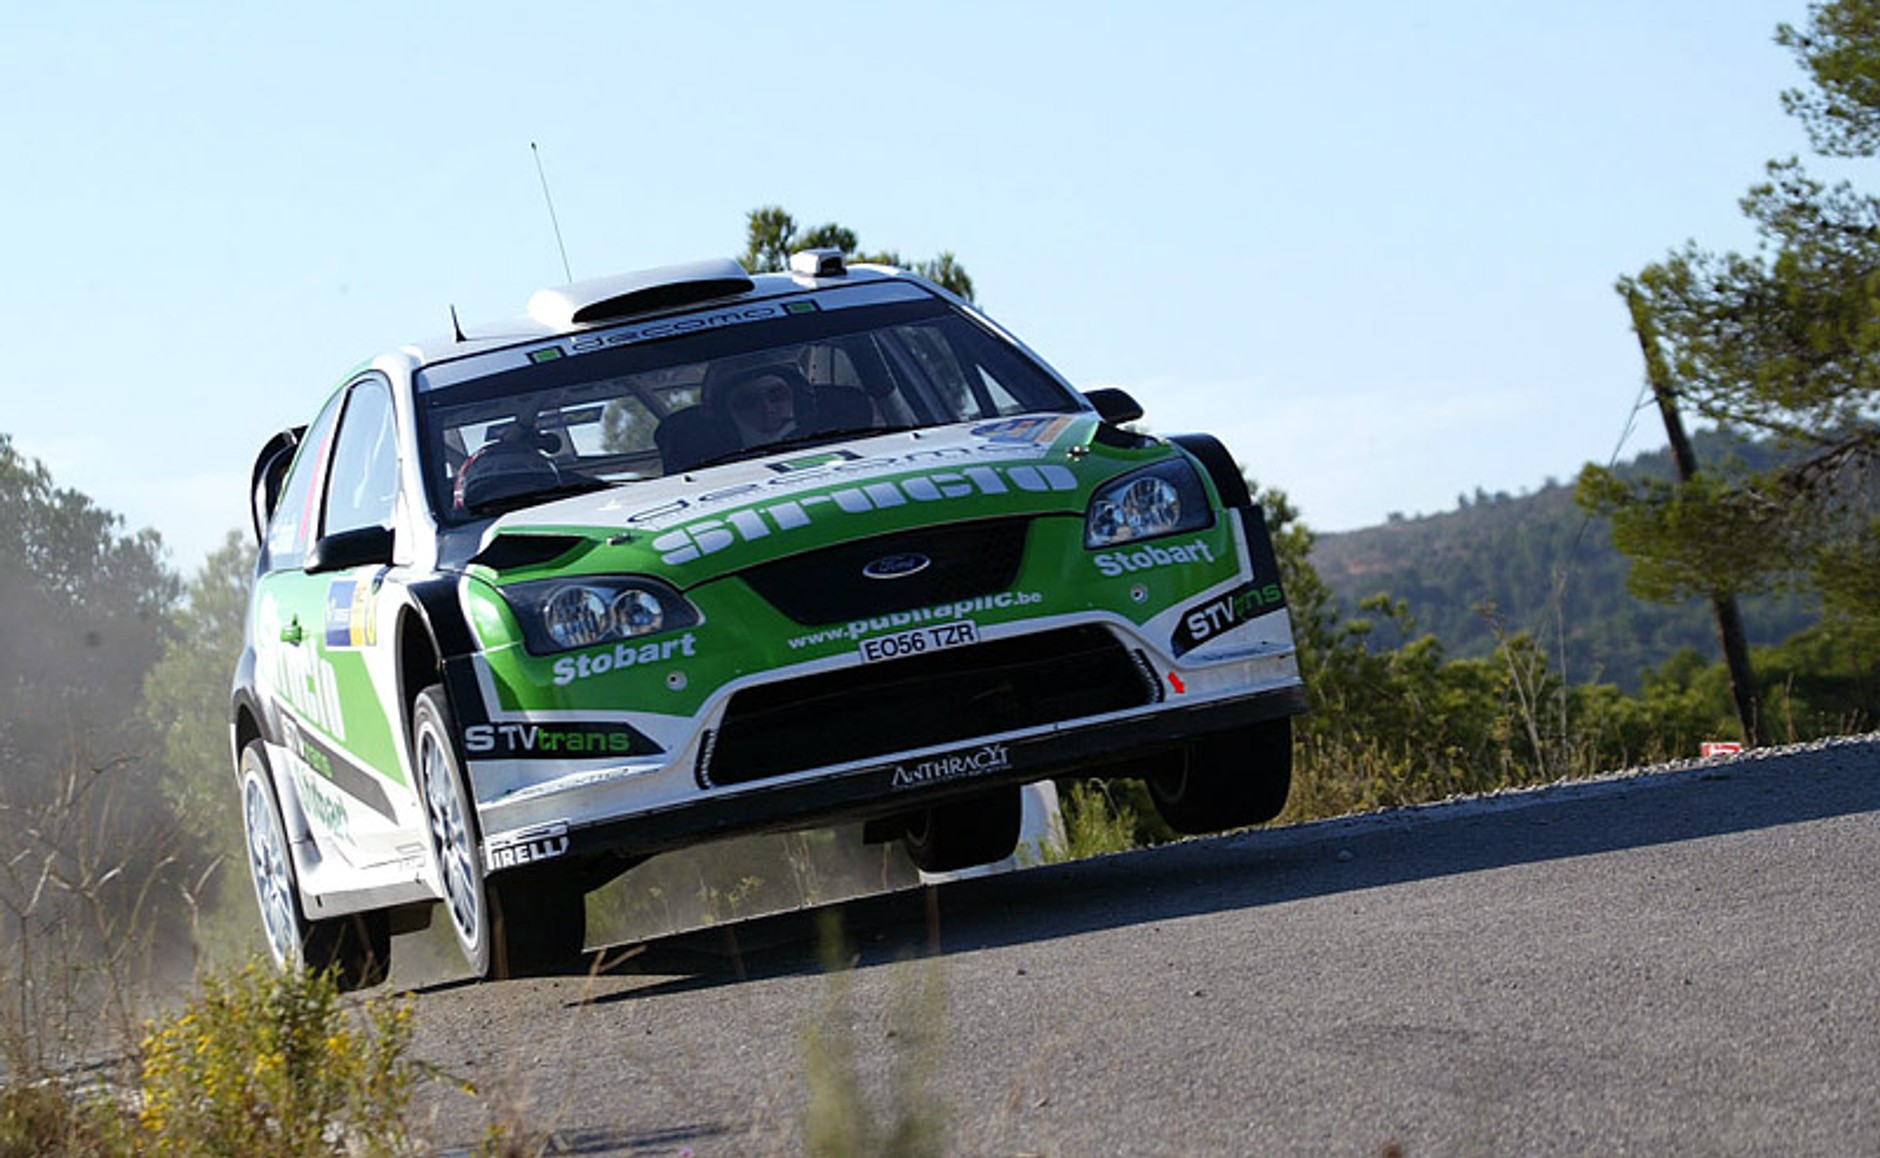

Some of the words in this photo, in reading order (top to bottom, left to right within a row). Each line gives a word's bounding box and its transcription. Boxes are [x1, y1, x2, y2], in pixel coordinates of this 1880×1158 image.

[652, 464, 1079, 565] structo
[1094, 540, 1215, 576] Stobart
[553, 633, 697, 686] Stobart
[864, 634, 925, 661] EO56
[928, 623, 975, 648] TZR
